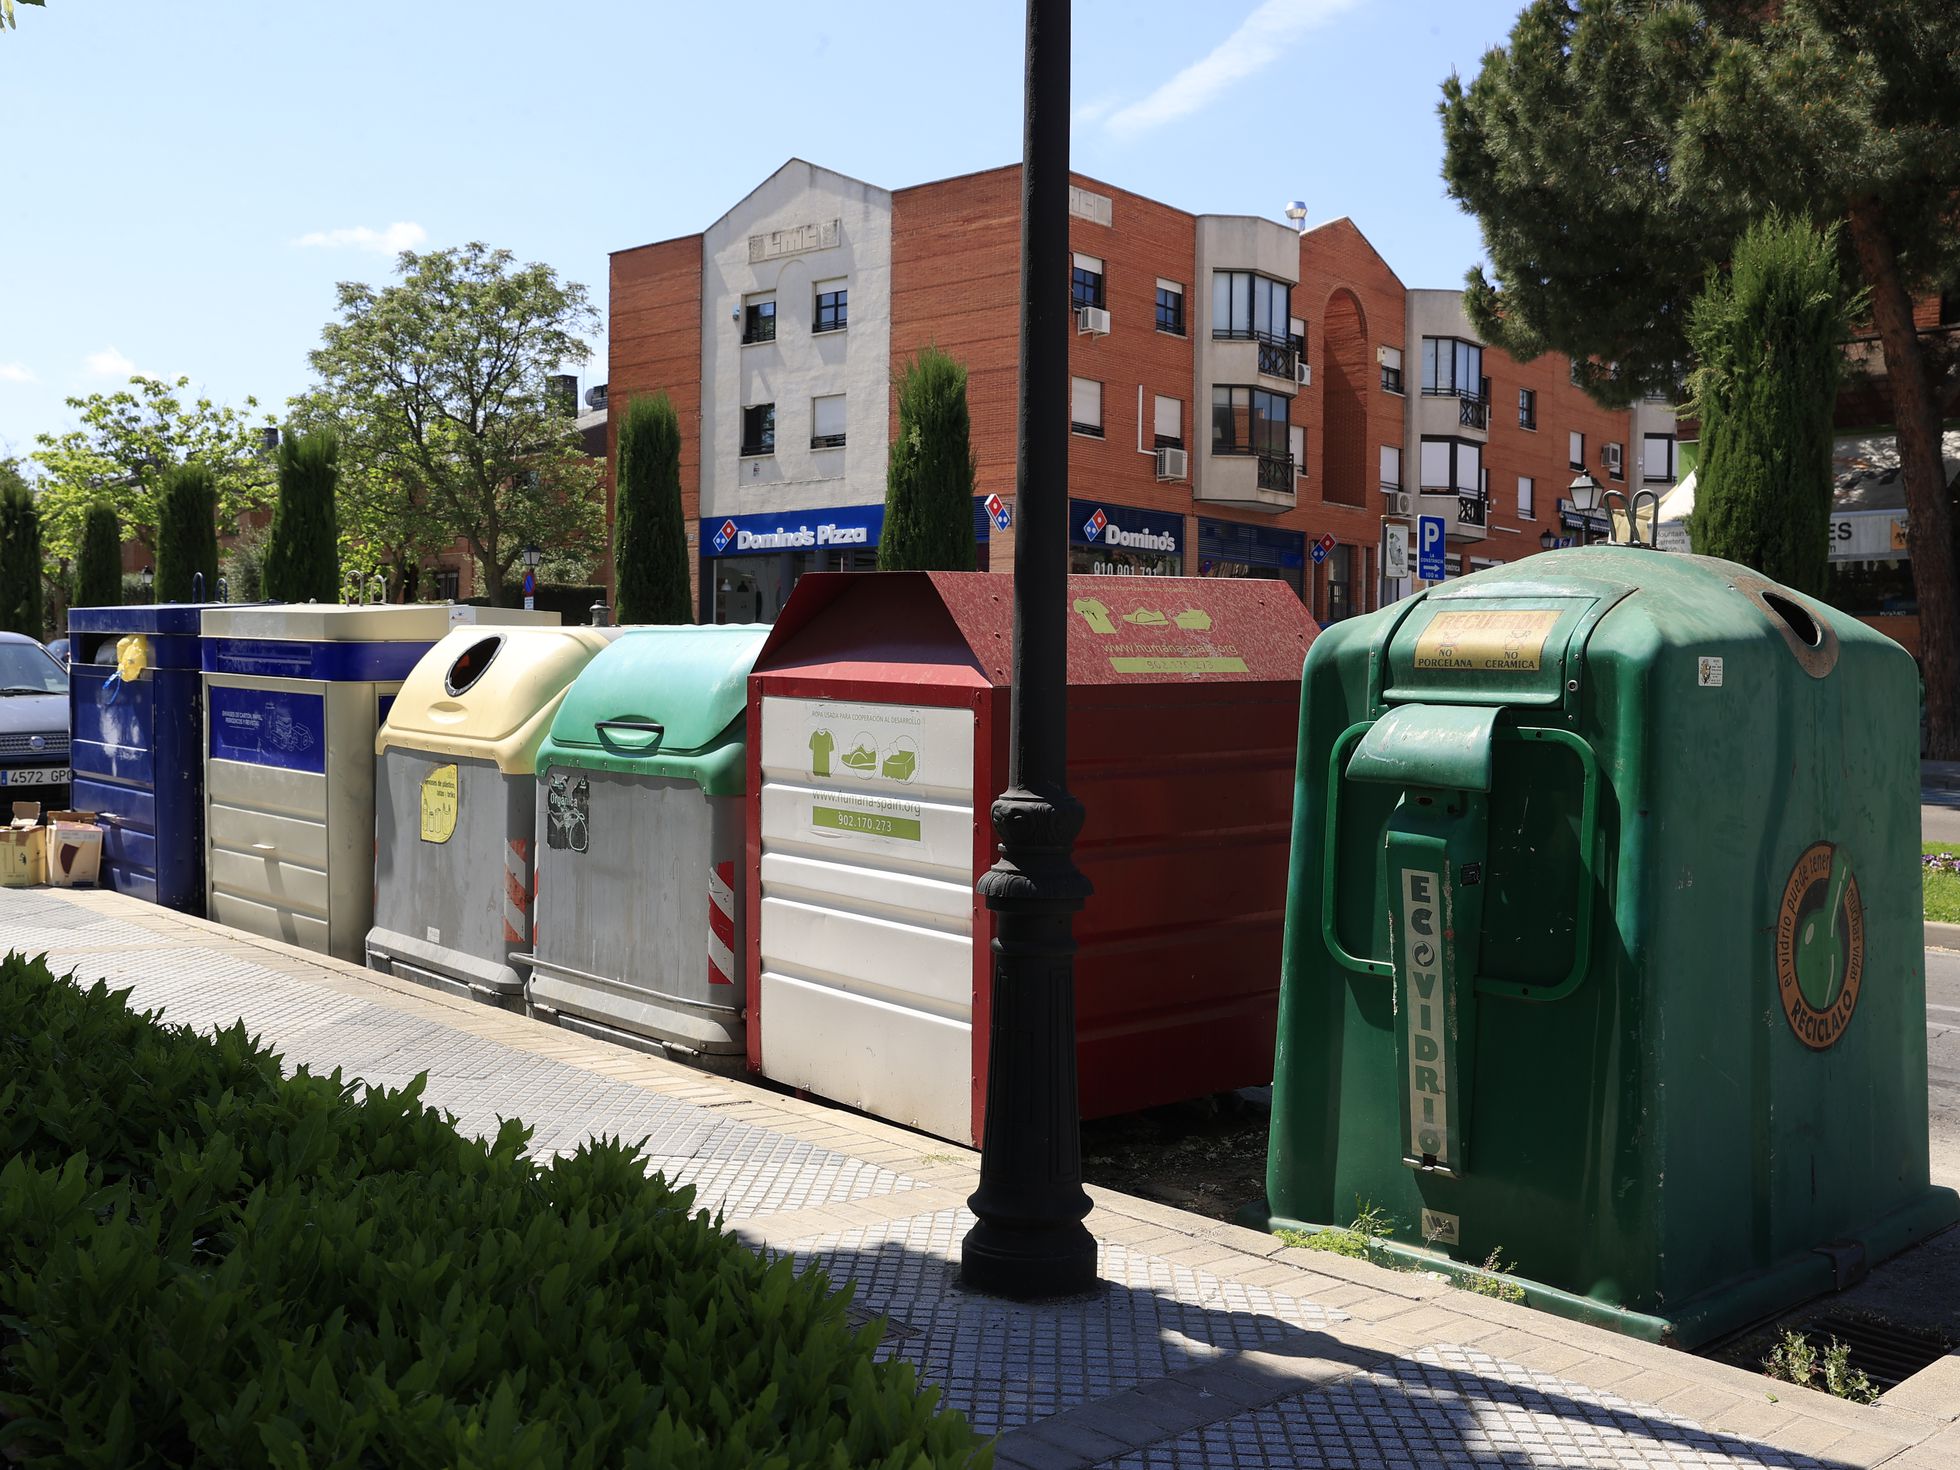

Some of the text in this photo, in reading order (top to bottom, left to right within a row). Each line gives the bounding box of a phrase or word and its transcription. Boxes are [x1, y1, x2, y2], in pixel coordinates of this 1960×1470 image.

[737, 524, 868, 550] Domino's Pizza
[1105, 524, 1176, 552] Domino's
[1424, 522, 1440, 552] P
[1418, 658, 1473, 668] PORCELANA
[1438, 649, 1453, 657] NO
[1504, 651, 1518, 660] NO
[10, 771, 44, 784] 4572
[838, 813, 892, 832] 902.170.273
[1779, 855, 1830, 988] el vidrio puede tener
[1846, 887, 1862, 983] muchas vidas
